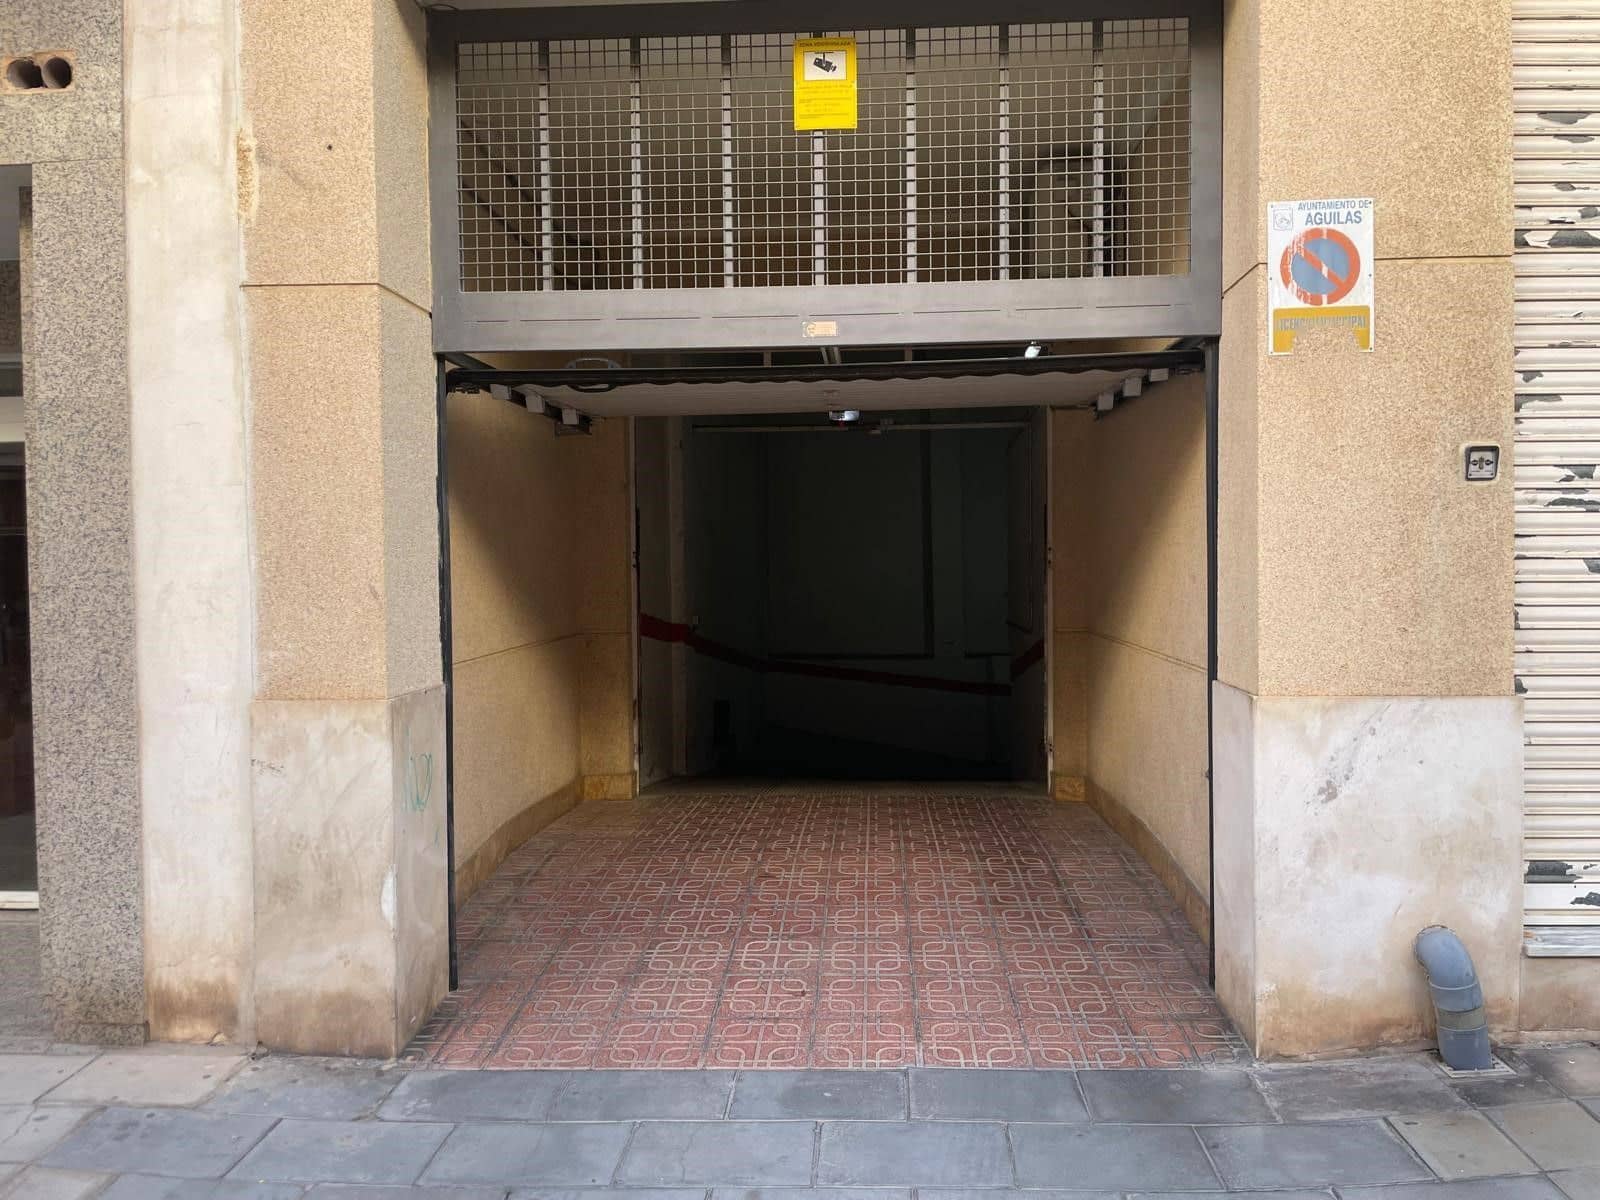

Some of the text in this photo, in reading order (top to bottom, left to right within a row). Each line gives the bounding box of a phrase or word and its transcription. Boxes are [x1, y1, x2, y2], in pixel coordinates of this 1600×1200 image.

[1298, 199, 1369, 210] AYUNTAMIENTO DE
[1305, 210, 1362, 226] AGUILAS
